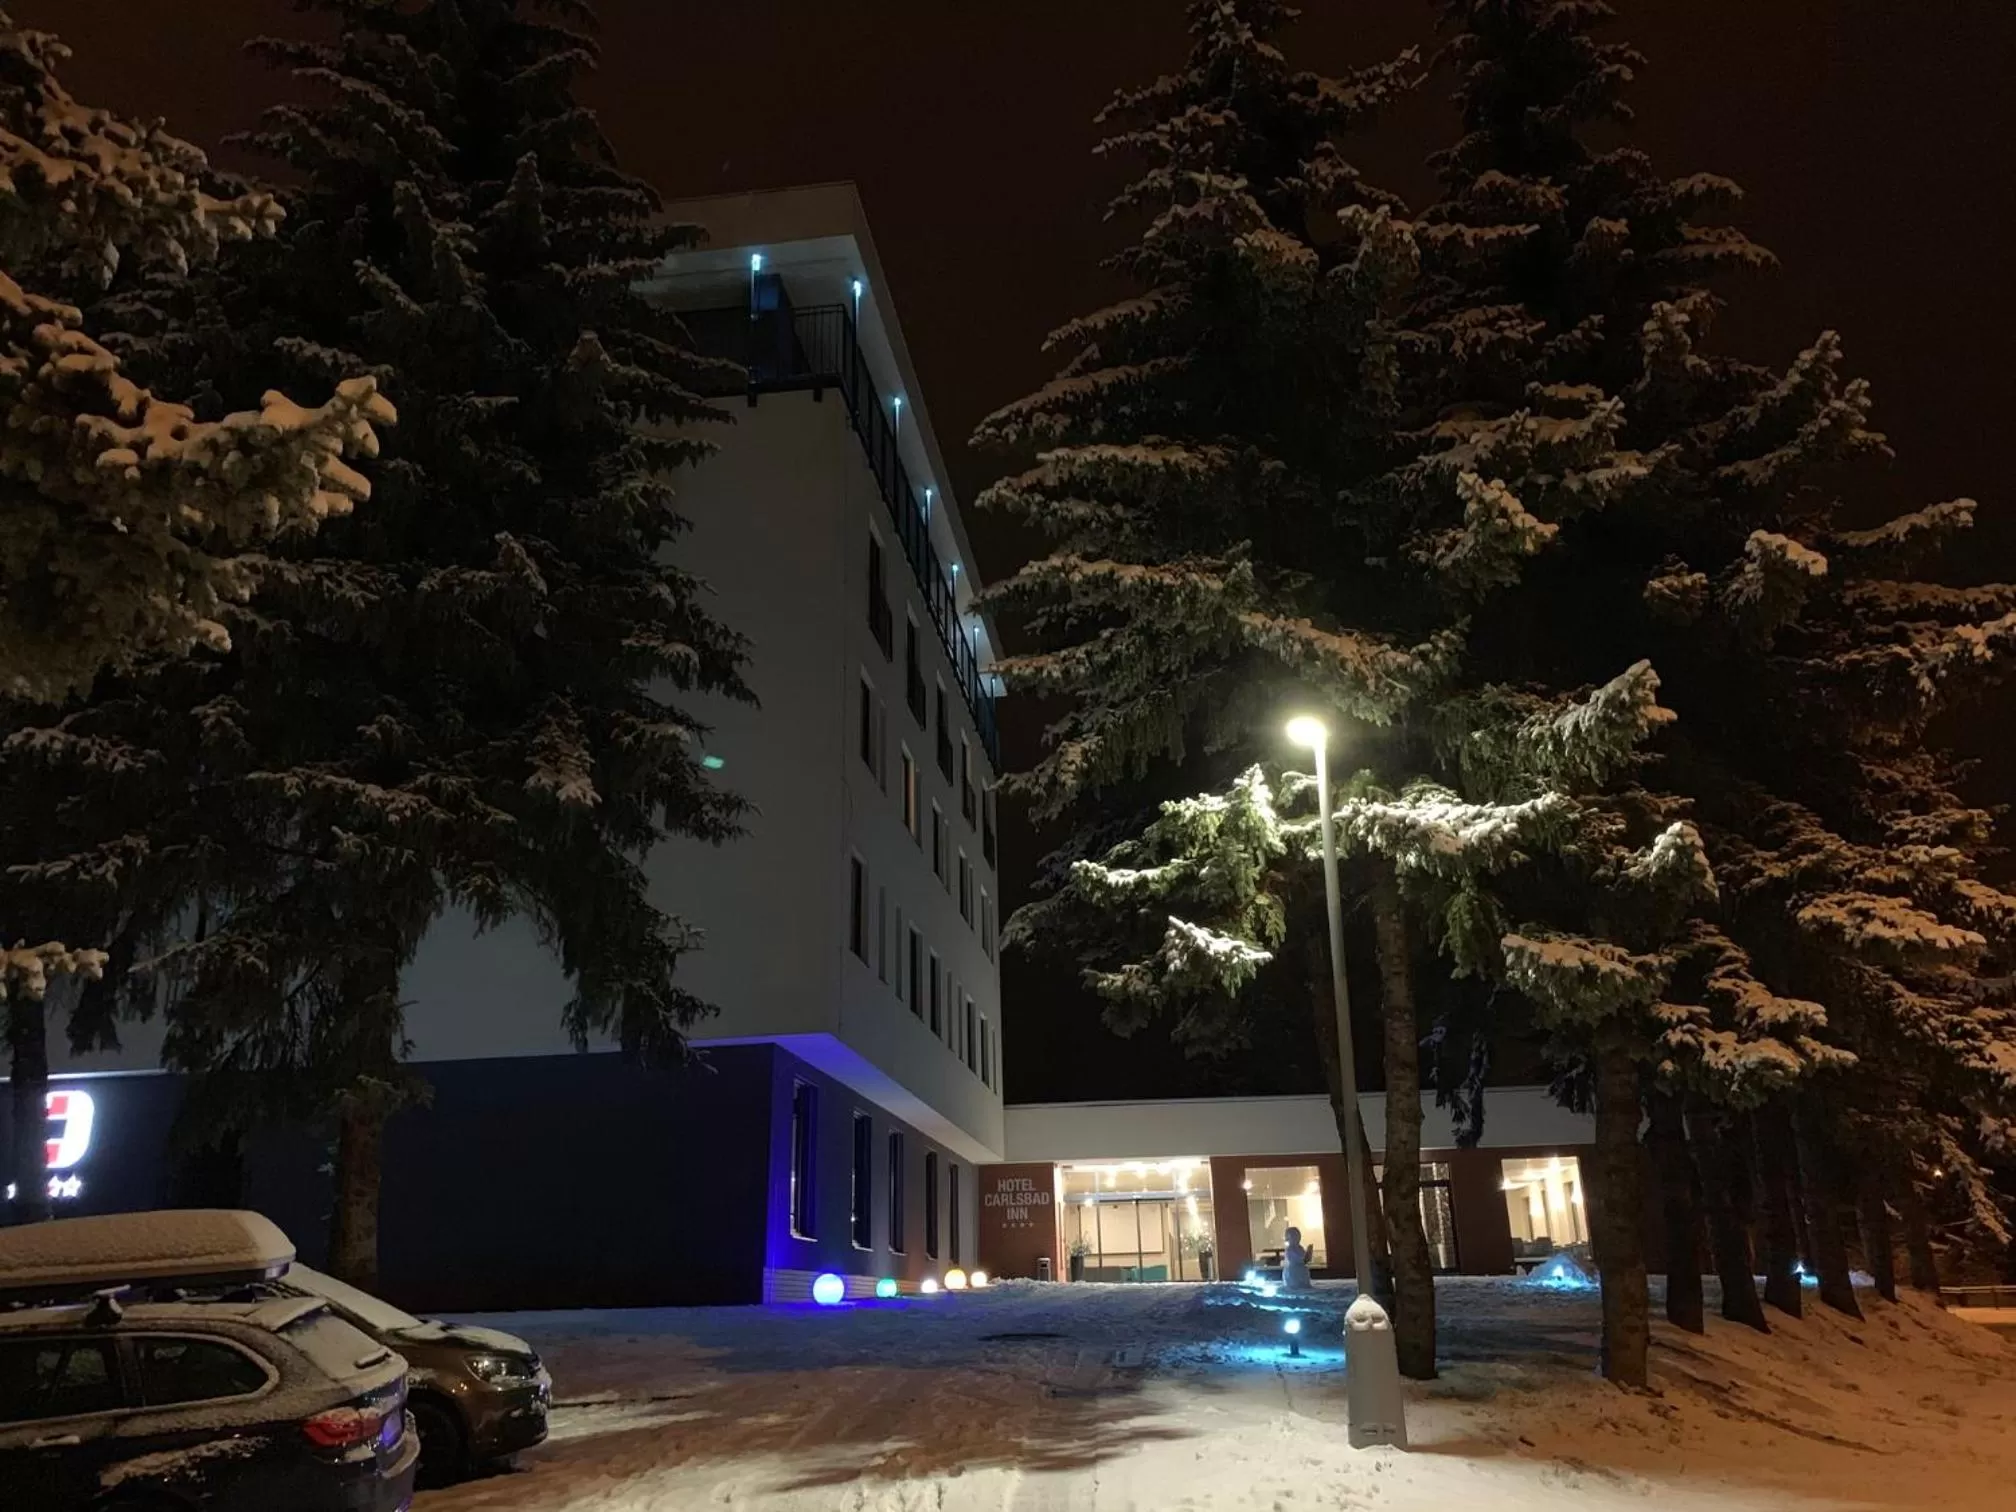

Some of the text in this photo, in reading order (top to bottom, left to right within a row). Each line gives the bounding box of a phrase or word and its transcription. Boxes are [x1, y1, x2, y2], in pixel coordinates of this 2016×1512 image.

[997, 1178, 1036, 1192] HOTEL
[984, 1192, 1049, 1206] CARLSBAD
[1006, 1207, 1028, 1220] INN
